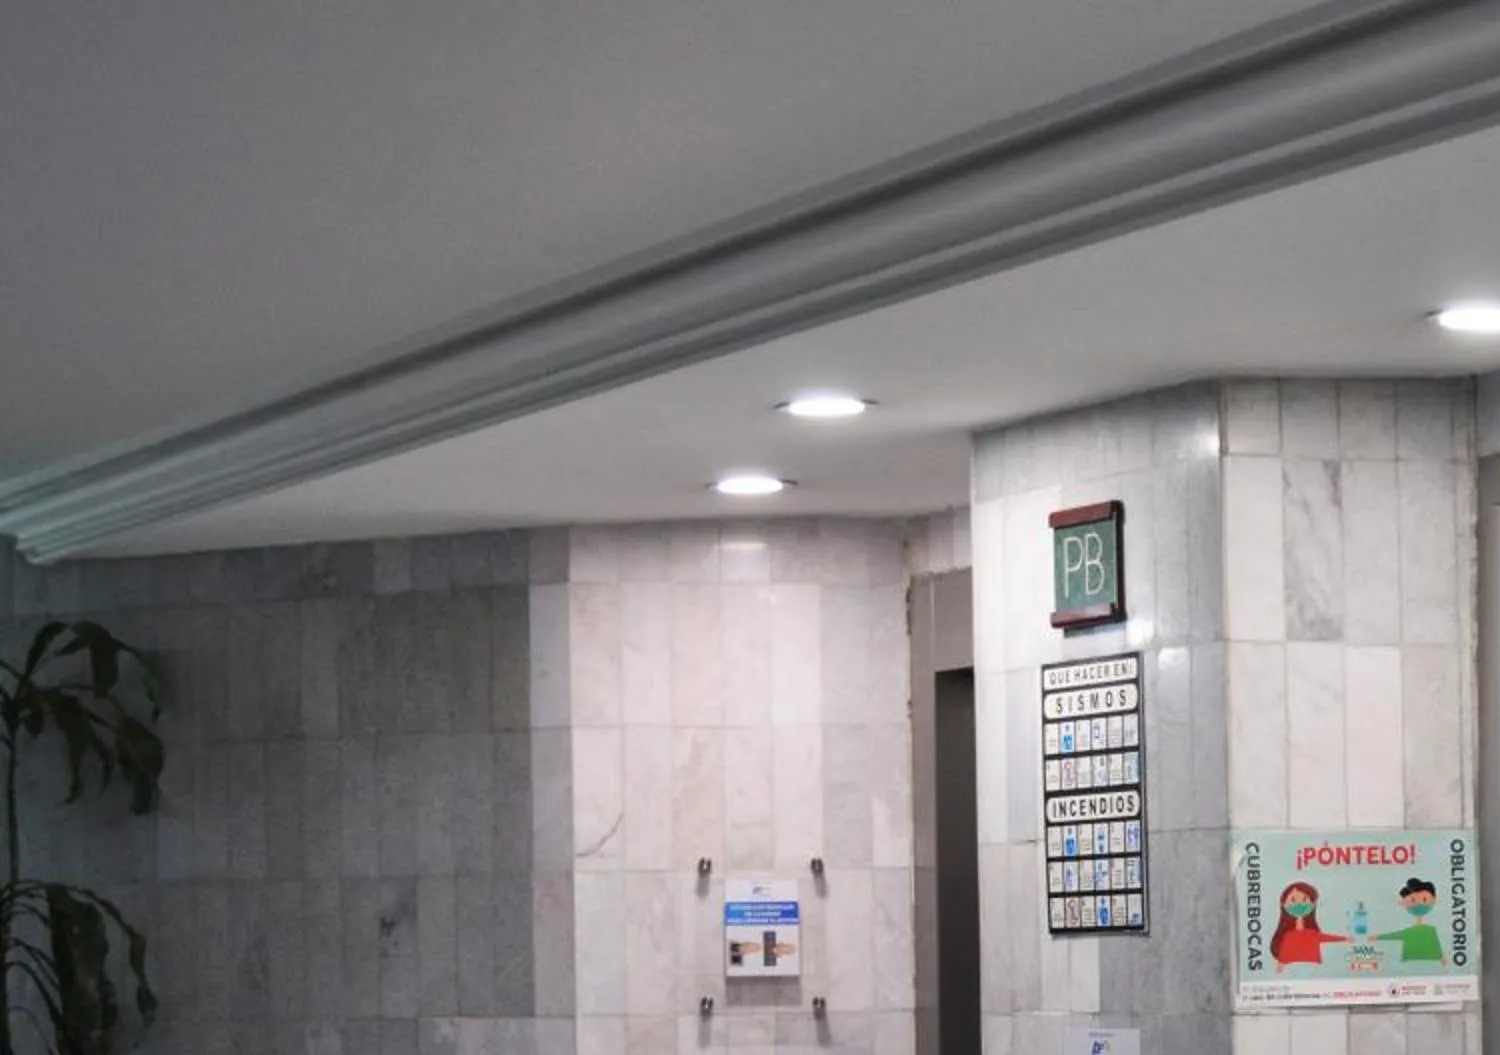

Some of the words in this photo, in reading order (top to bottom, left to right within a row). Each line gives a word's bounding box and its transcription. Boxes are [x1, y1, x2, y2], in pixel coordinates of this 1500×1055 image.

[1063, 531, 1105, 599] PB
[1055, 689, 1127, 714] SISMOS
[1052, 794, 1135, 818] INCENDIOS
[1296, 841, 1416, 870] ¡PÓNTELO!
[1245, 841, 1263, 972] CUBREBOCAS
[1450, 839, 1468, 967] OBLIGATORIO
